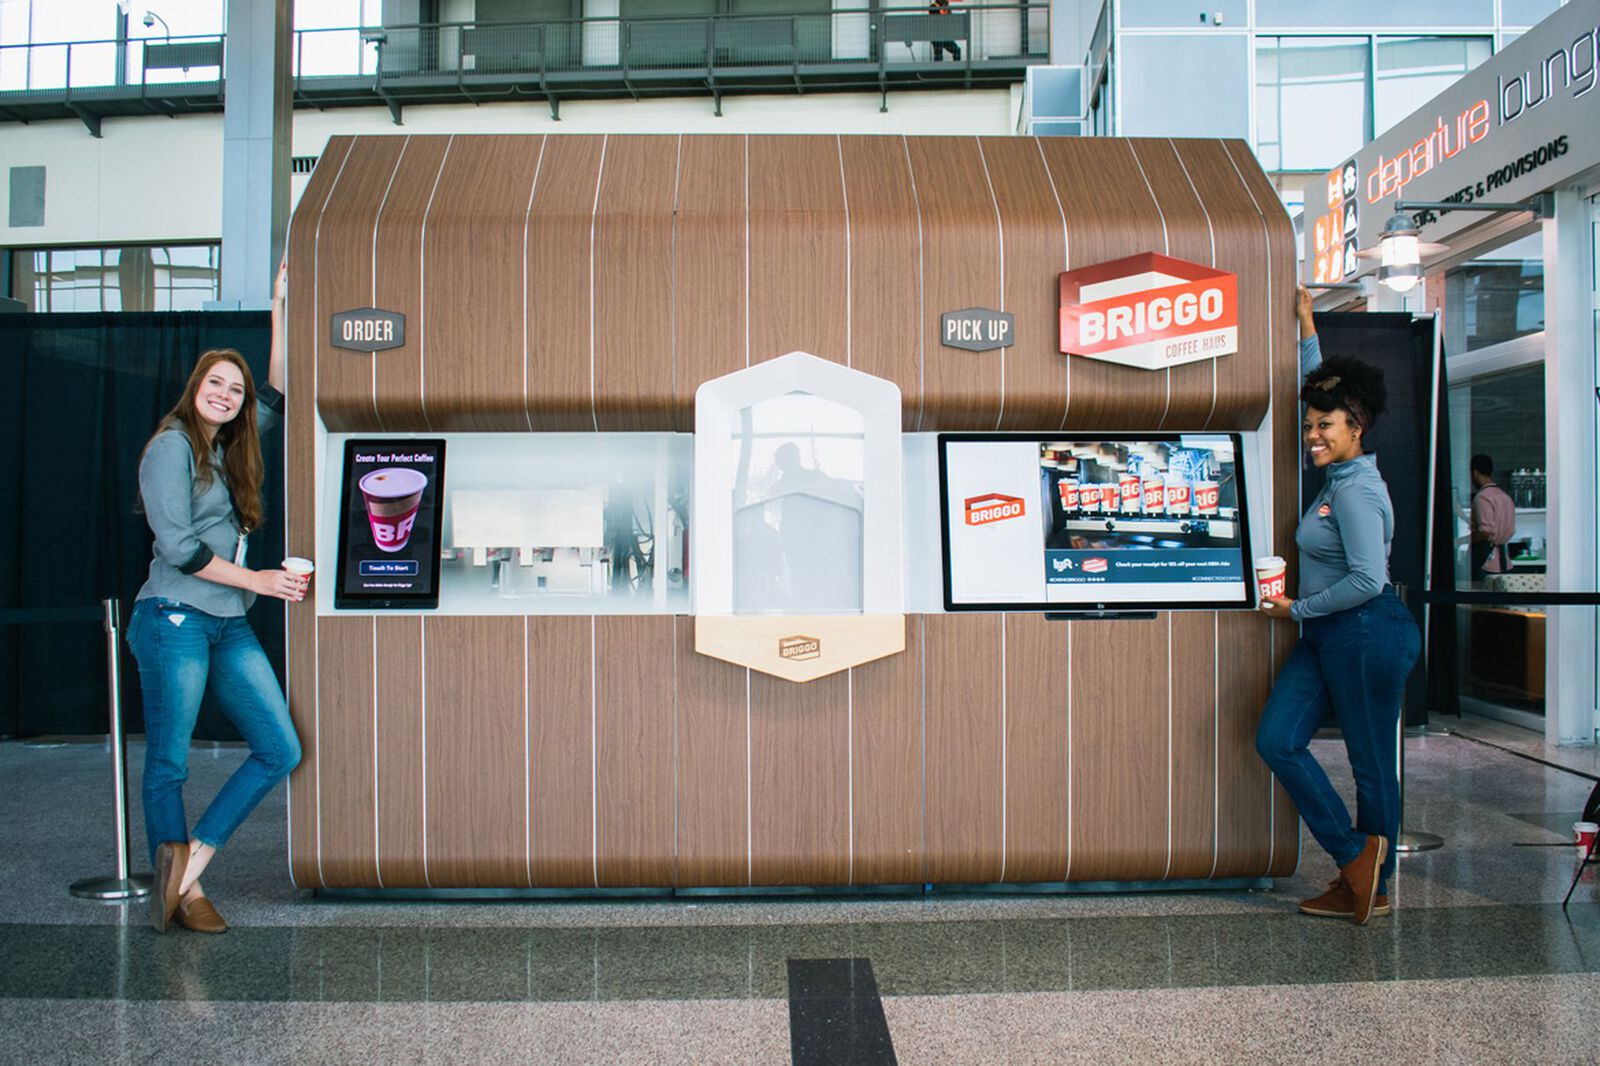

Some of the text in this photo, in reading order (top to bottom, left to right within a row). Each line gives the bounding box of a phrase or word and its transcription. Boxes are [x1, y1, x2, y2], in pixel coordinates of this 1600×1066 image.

[1366, 25, 1600, 204] departure loung
[1475, 181, 1485, 198] &
[1486, 135, 1569, 192] PROVISIONS
[1079, 288, 1223, 347] BRIGGO
[342, 320, 394, 341] ORDER
[947, 319, 1009, 341] PICK UP
[1165, 335, 1226, 359] COFFEE HAUS
[355, 453, 434, 463] Create Your Perfect Coffee
[971, 504, 1021, 524] BRIGGO
[783, 642, 817, 656] BRIGGO
